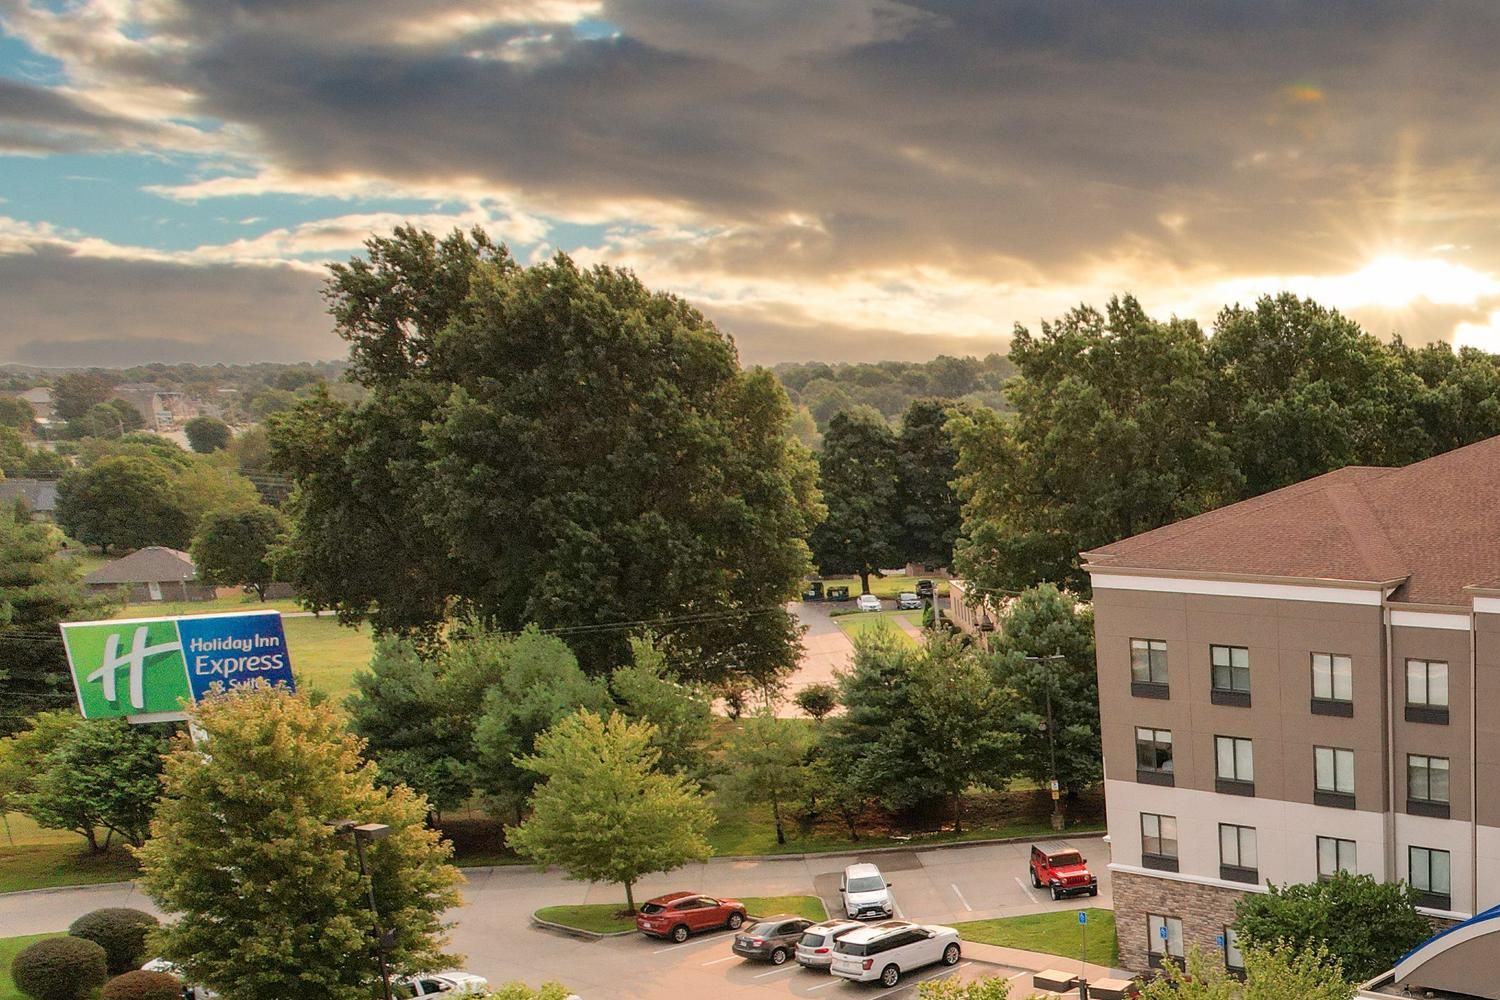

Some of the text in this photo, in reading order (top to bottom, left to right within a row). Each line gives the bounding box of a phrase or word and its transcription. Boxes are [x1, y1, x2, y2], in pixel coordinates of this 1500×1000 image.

[189, 633, 280, 652] Holiday Inn
[195, 654, 285, 679] Express
